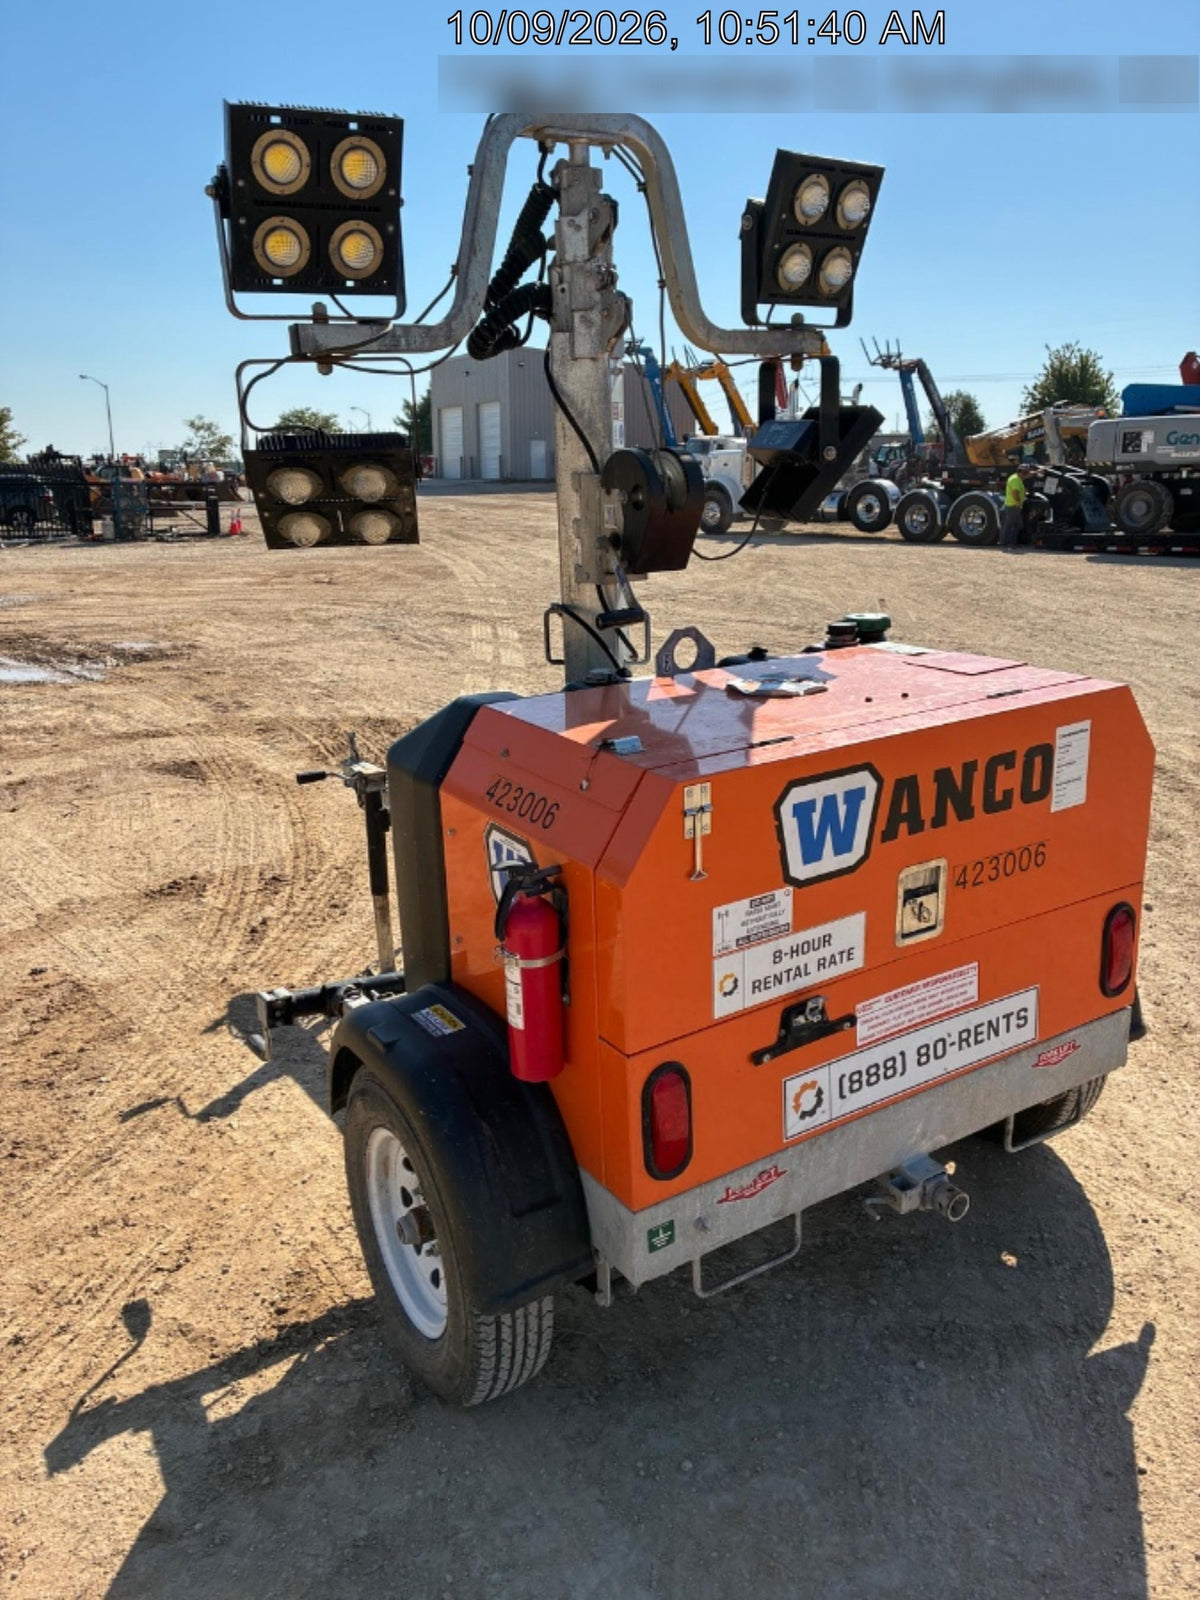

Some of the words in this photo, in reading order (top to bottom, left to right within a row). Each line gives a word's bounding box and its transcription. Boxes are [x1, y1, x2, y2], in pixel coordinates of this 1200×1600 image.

[1166, 430, 1200, 446] Gen
[486, 779, 561, 830] 423006
[790, 742, 1054, 867] WANCO
[954, 843, 1047, 889] 423006
[751, 966, 811, 995] RENTAL
[817, 947, 856, 971] RATE
[773, 933, 833, 964] 8-HOUR
[838, 1050, 907, 1100] (888)
